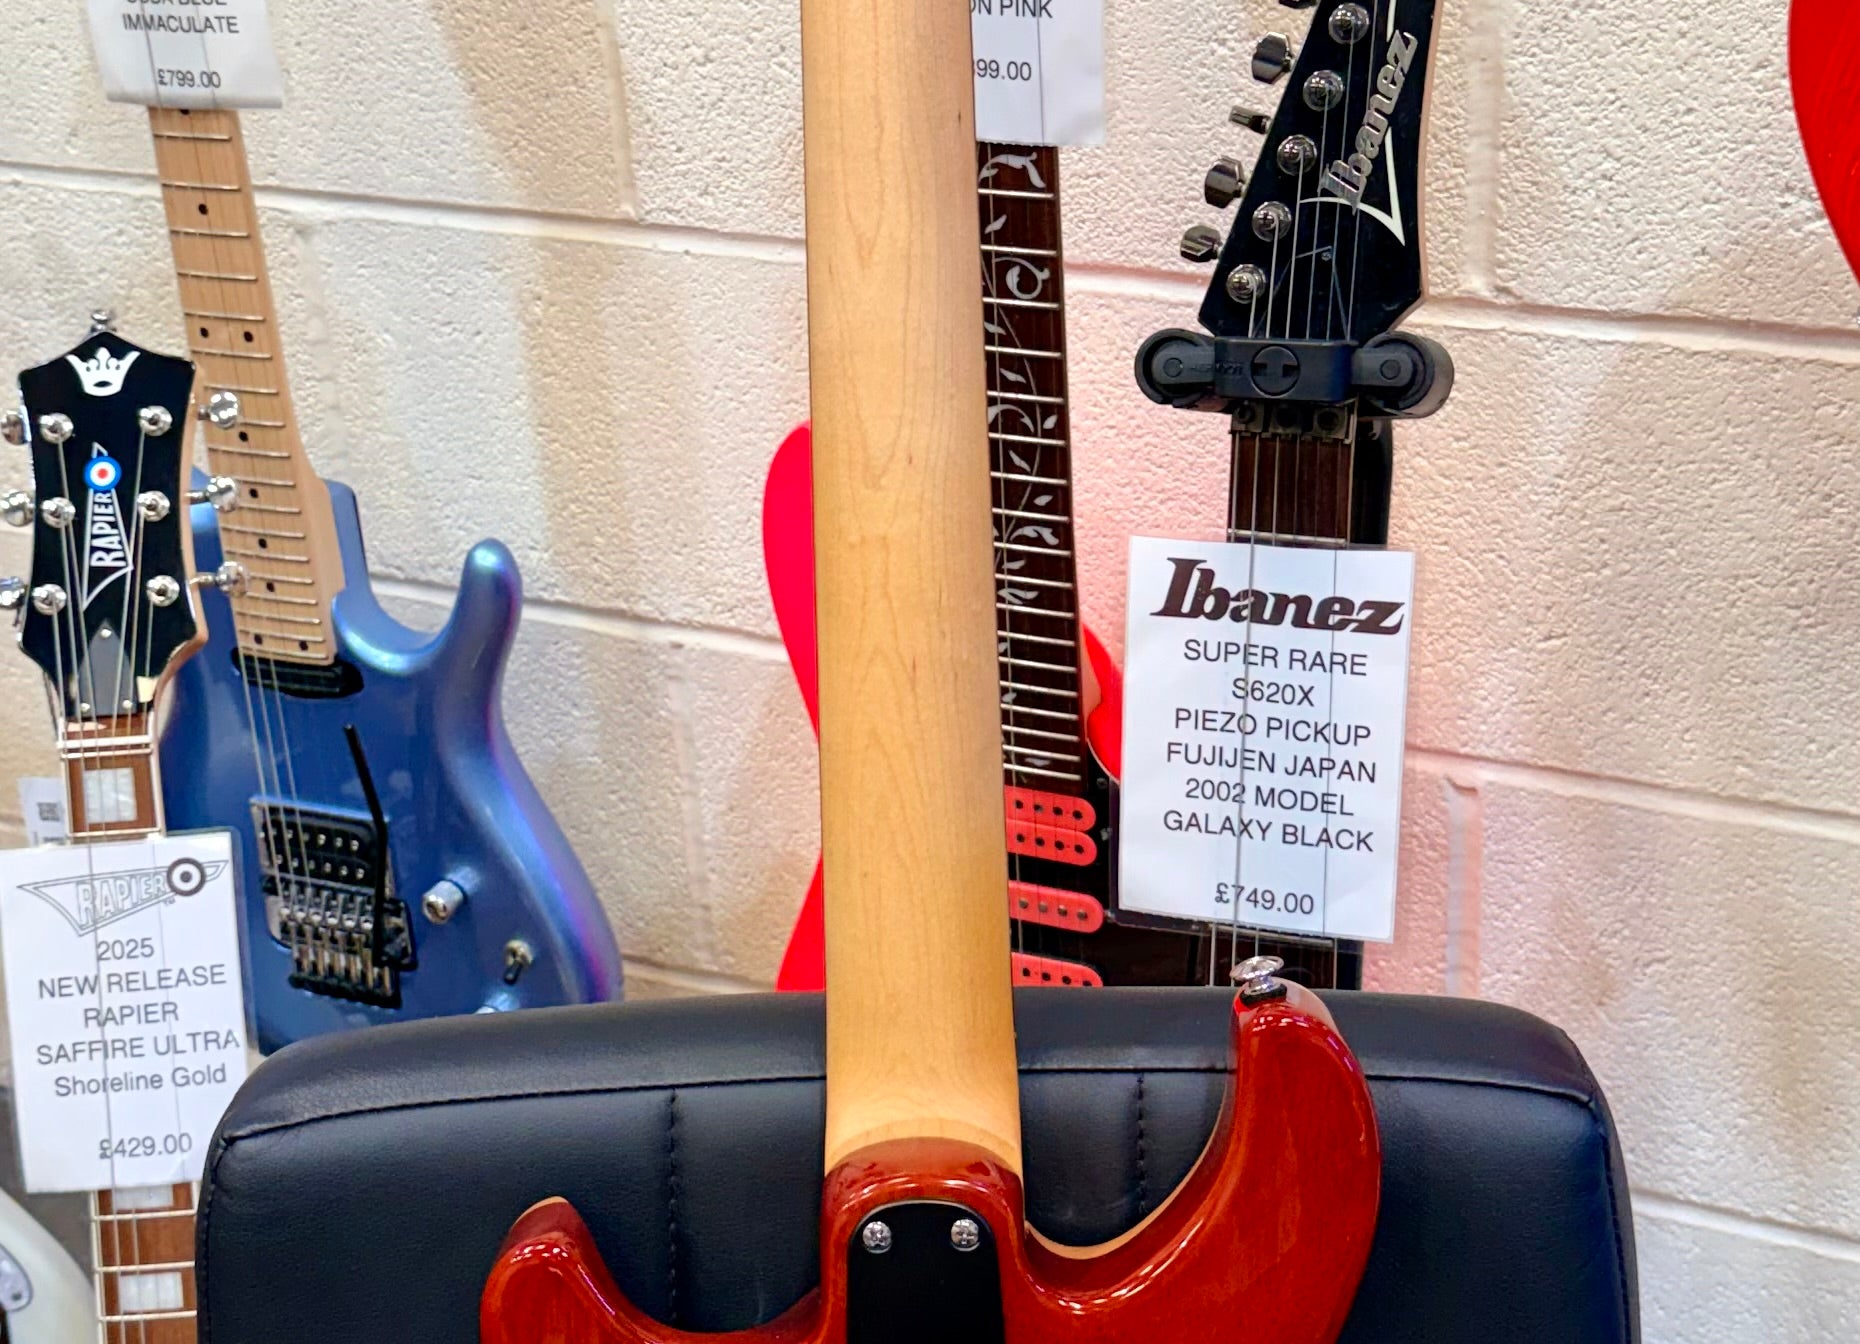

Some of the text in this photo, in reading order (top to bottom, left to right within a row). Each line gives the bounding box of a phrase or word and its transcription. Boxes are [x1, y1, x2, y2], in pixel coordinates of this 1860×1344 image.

[122, 14, 240, 34] IMMACULATE
[158, 69, 222, 89] £799.00
[972, 58, 1032, 81] 99.00
[1317, 29, 1418, 216] Ibanez
[90, 492, 127, 567] RAPIER
[1149, 557, 1406, 635] Ibanez
[1183, 639, 1368, 676] SUPER RARE
[1231, 678, 1315, 708] S620X
[1174, 708, 1372, 747] PIEZO PICKUP
[1166, 742, 1377, 783] FUJIJEN JAPAN
[1184, 778, 1355, 816] 2002 MODEL
[1163, 810, 1375, 852] GALAXY BLACK
[76, 871, 167, 928] RAPIER
[1214, 882, 1315, 915] £749.00
[97, 937, 155, 961] 2025
[38, 964, 227, 999] NEW RELEASE
[84, 1002, 179, 1028] RAPIER
[36, 1030, 240, 1065] SAFFIRE ULTRA
[54, 1063, 228, 1098] Shoreline Gold
[99, 1132, 193, 1160] £429.00
